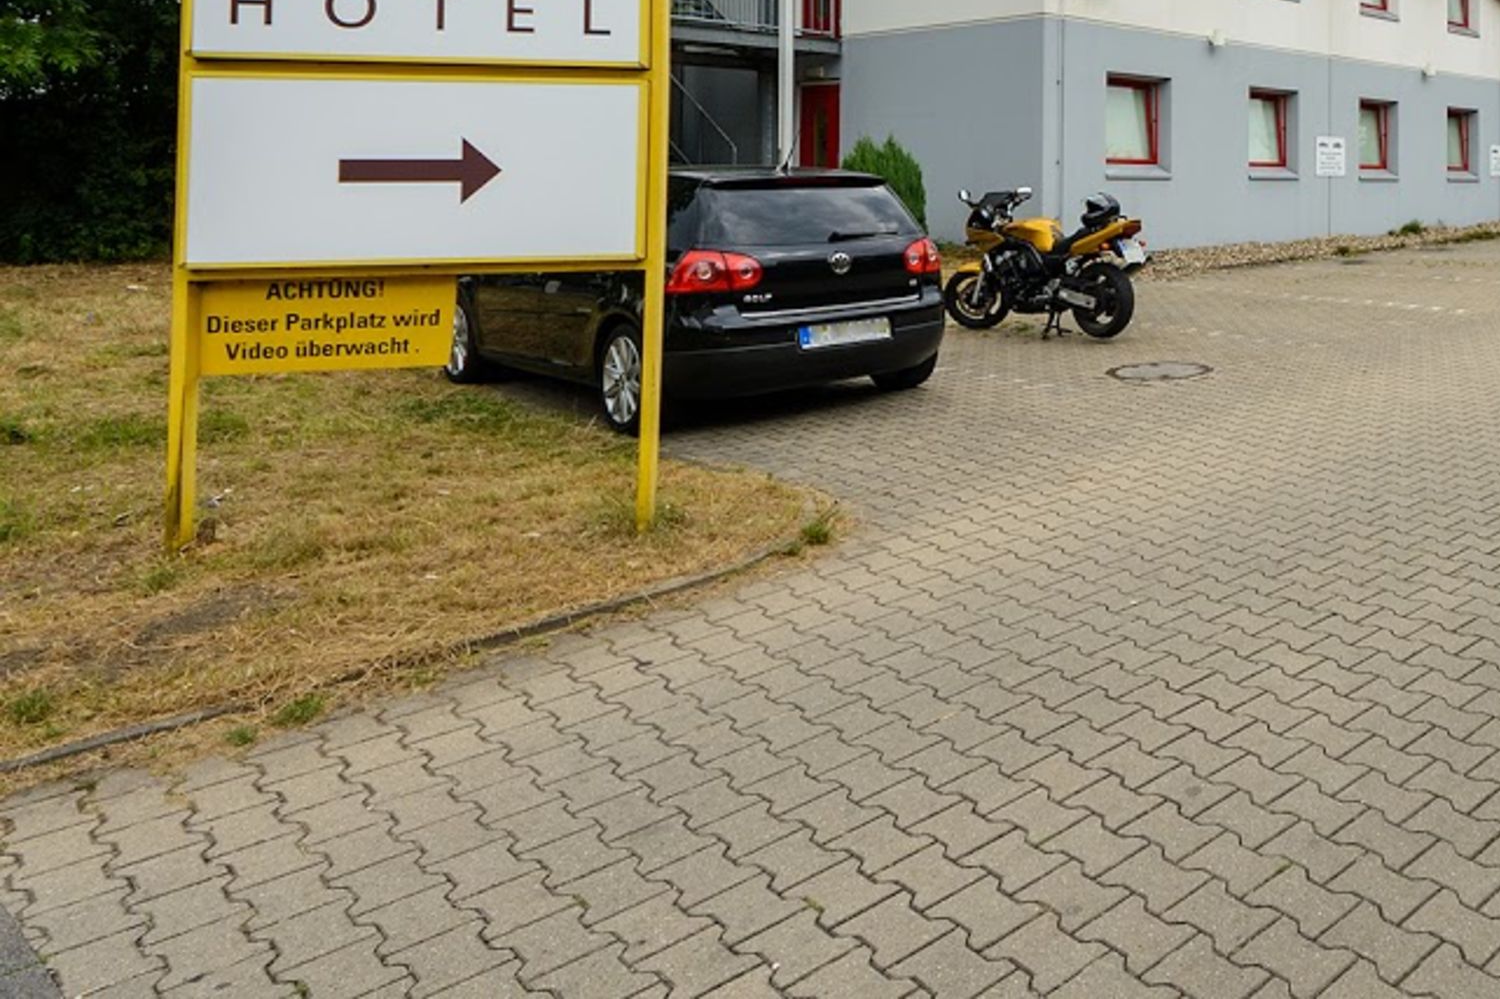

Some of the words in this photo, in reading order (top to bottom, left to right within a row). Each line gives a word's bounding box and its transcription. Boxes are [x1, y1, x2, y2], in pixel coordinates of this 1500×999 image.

[266, 280, 384, 300] ACHTUNG!
[207, 315, 278, 334] Dieser
[286, 311, 387, 333] Parkplatz
[392, 308, 441, 327] wird
[225, 342, 288, 360] Video
